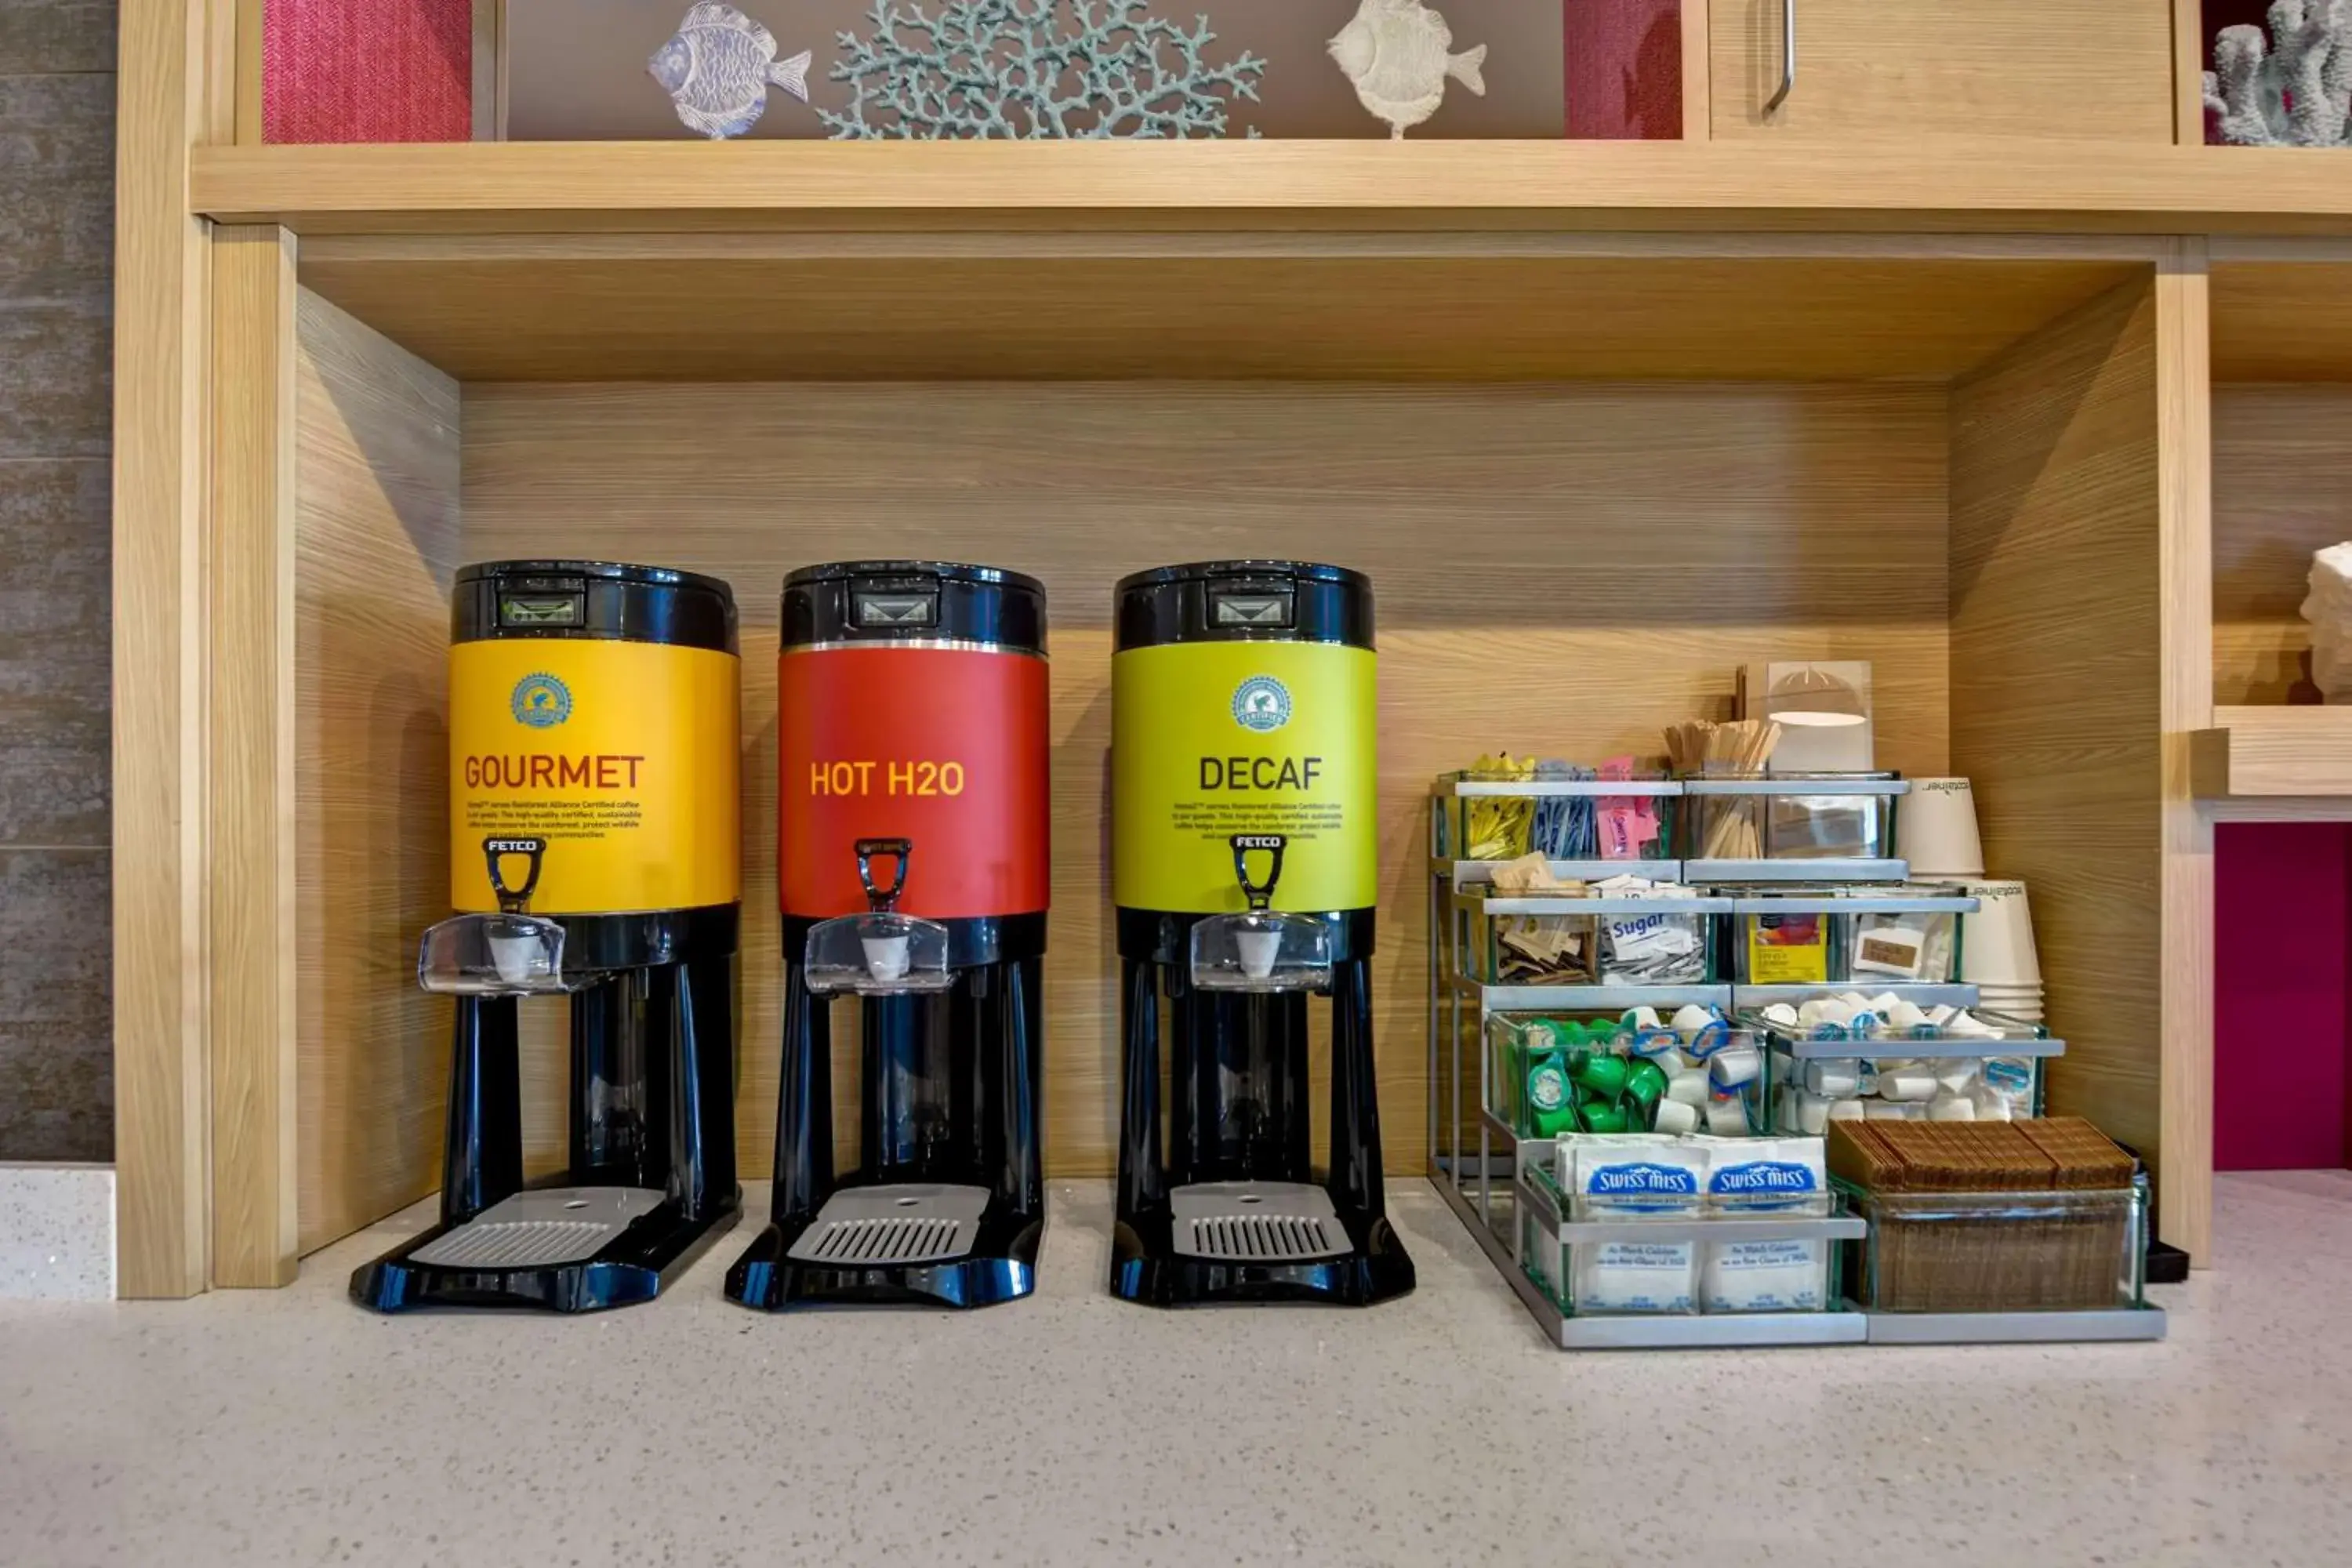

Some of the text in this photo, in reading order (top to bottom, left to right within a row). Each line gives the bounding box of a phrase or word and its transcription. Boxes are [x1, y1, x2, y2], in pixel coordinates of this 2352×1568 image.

[466, 755, 644, 789] GOURMET
[811, 761, 877, 796] HOT
[1200, 757, 1323, 790] DECAF
[488, 841, 537, 851] FETCO
[1236, 837, 1280, 848] FETCO
[1613, 913, 1664, 938] Sugar
